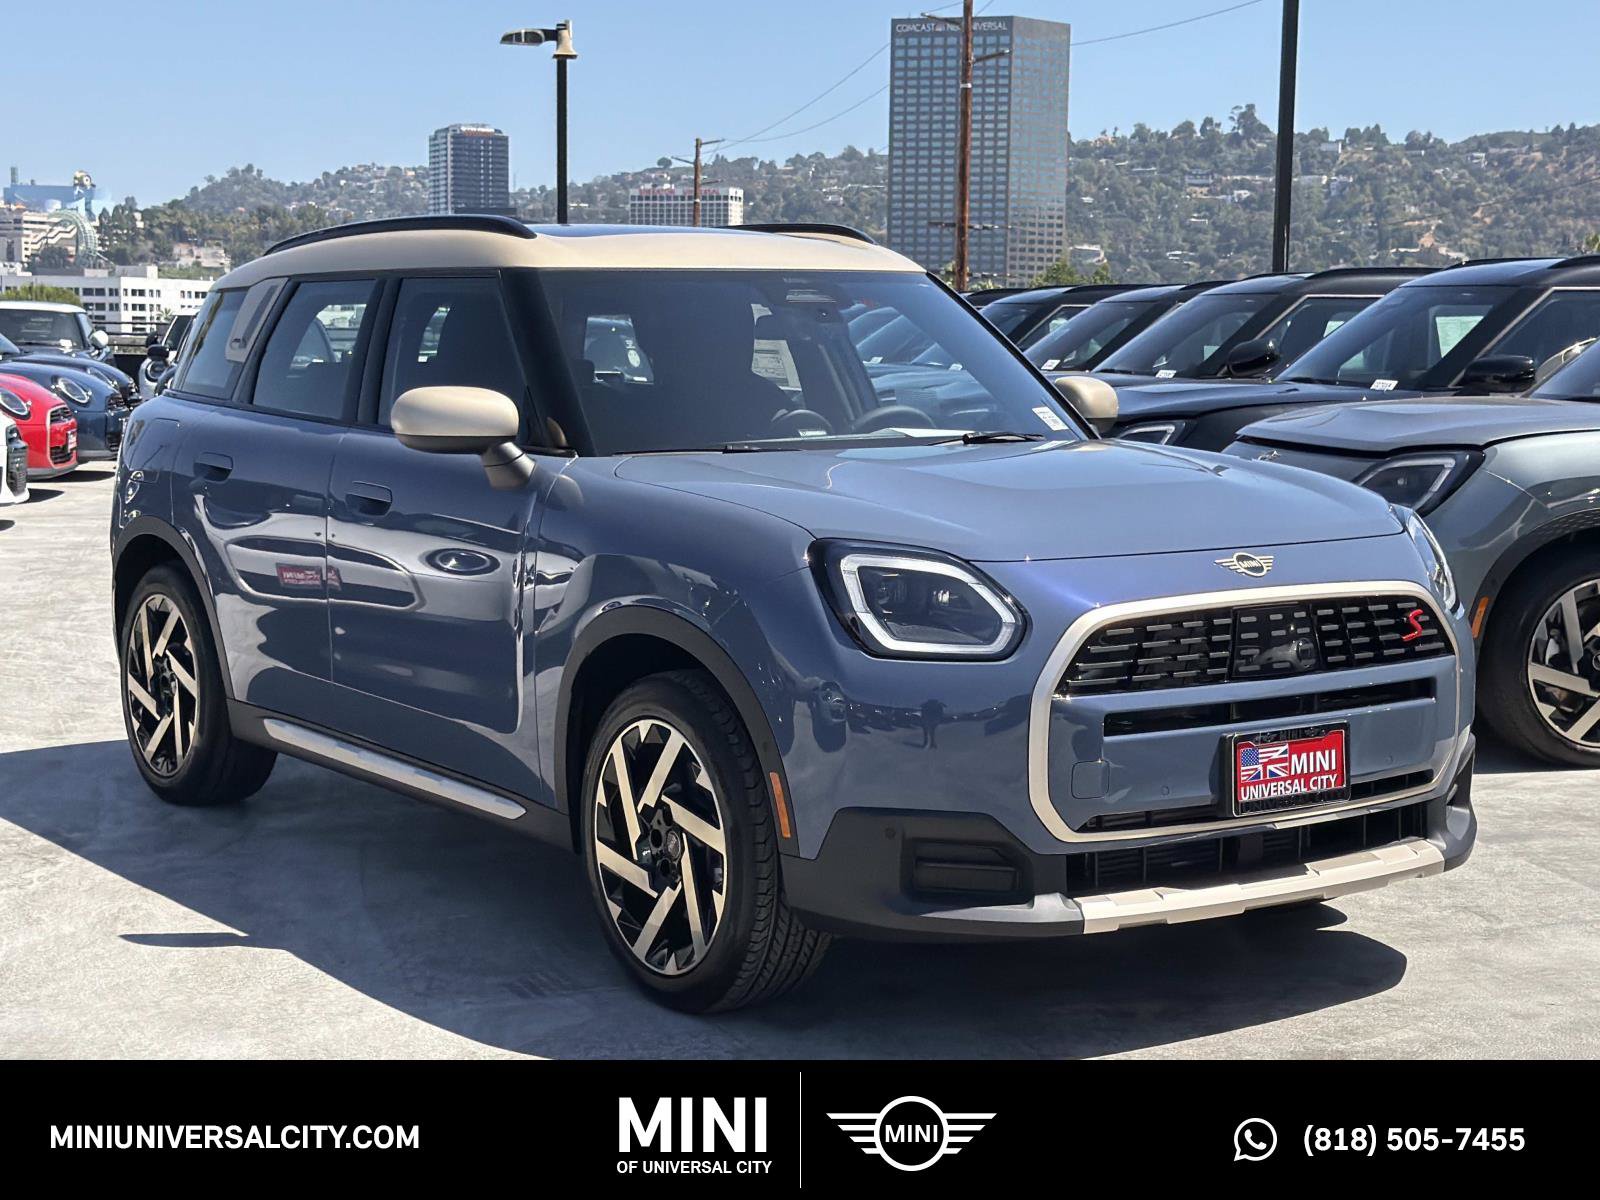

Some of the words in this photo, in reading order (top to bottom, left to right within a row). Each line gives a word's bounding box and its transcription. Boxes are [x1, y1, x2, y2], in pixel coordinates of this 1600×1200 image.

[895, 22, 935, 32] COMCAST
[1291, 749, 1336, 775] MINI
[1241, 778, 1308, 801] UNIVERSAL
[1309, 774, 1338, 791] CITY
